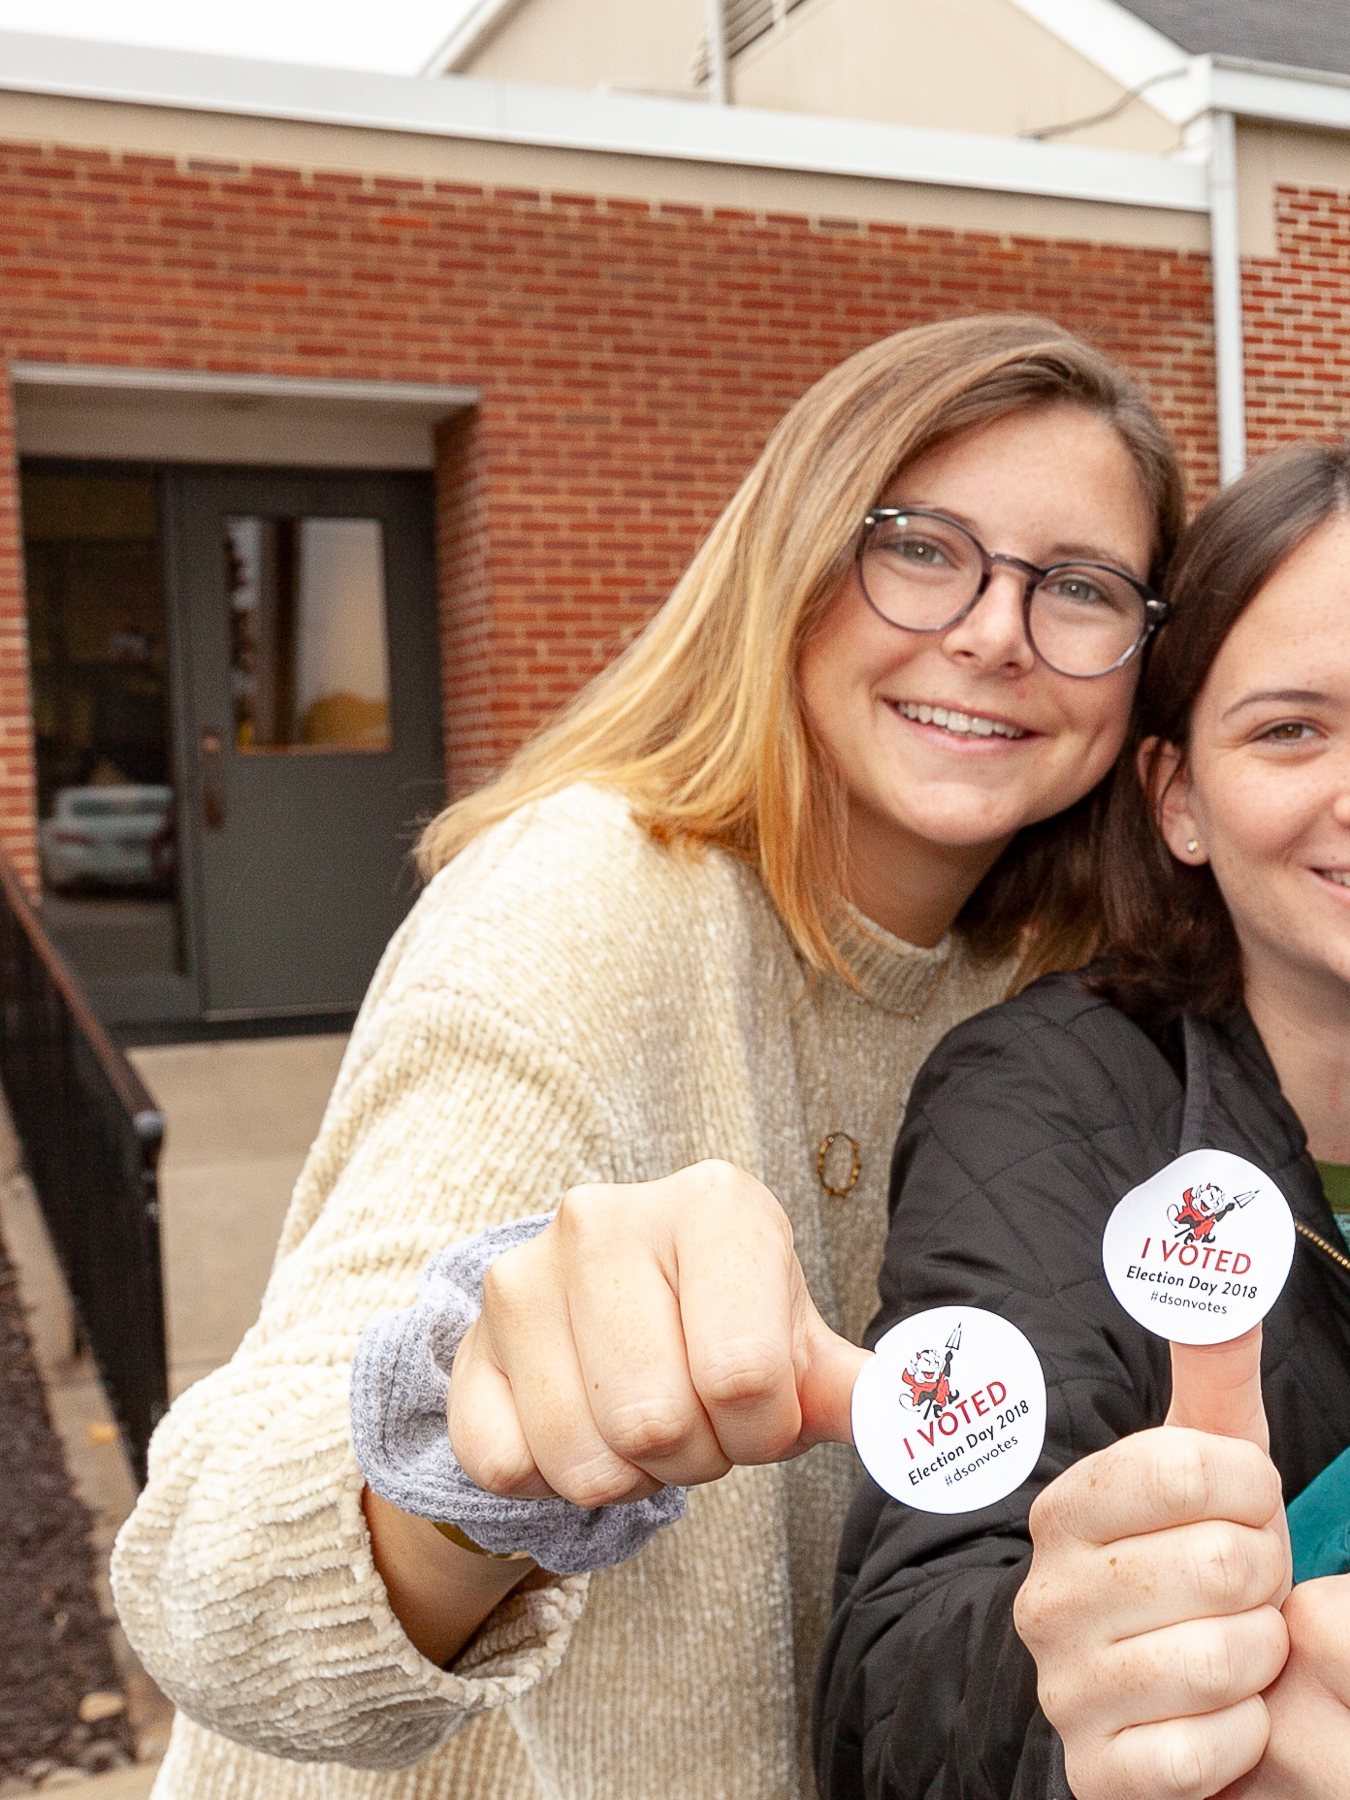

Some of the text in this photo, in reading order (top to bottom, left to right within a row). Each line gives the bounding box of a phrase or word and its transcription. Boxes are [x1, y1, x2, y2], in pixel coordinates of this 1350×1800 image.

[1141, 1237, 1252, 1275] I VOTED
[1126, 1265, 1258, 1299] Election Day 2018
[1150, 1290, 1228, 1315] #dsonvotes
[903, 1380, 1007, 1460] I VOTED
[907, 1400, 1030, 1486] Election Day 2018
[944, 1435, 1019, 1487] #dsonvotes
